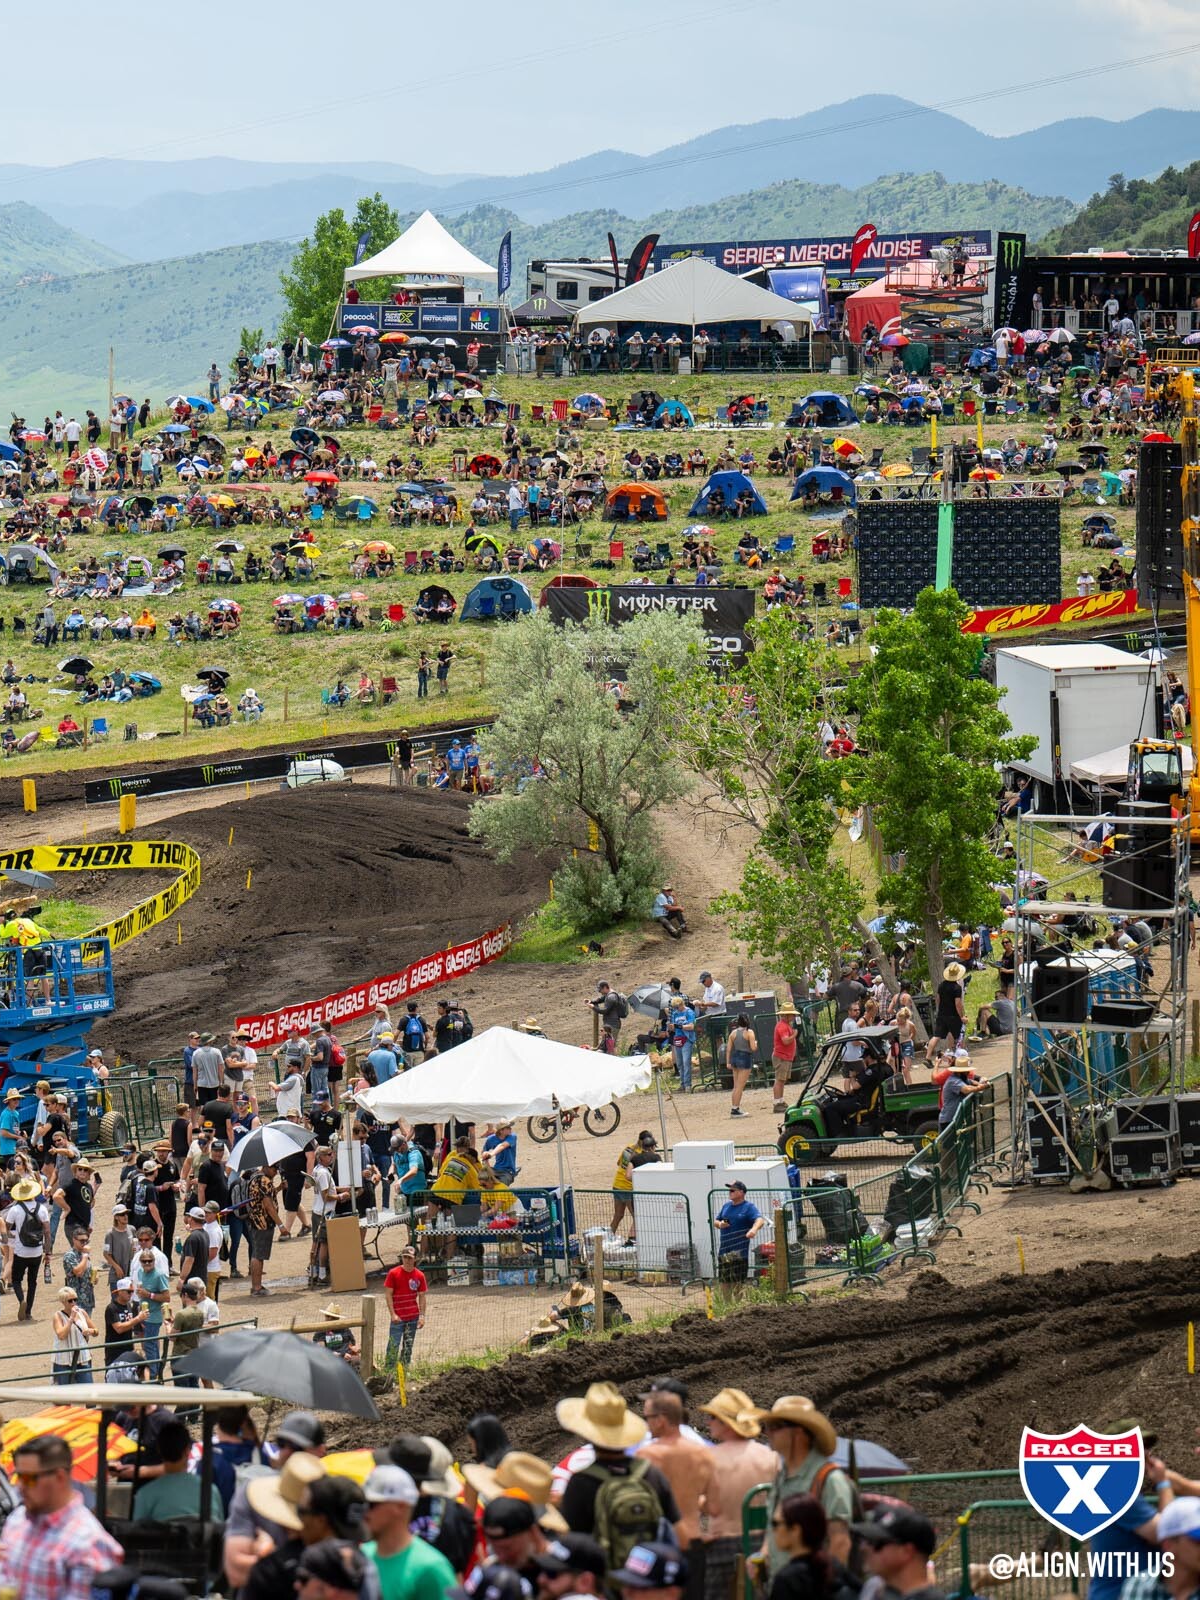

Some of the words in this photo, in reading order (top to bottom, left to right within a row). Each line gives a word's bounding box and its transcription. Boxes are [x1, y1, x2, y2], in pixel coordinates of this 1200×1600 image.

[723, 246, 785, 265] SERIES
[789, 239, 922, 262] MERCHNDISE
[343, 313, 376, 323] peacock
[470, 322, 490, 331] NBC
[618, 594, 718, 612] MONSTER
[1060, 590, 1125, 622] FMF
[214, 765, 243, 773] MONSTER
[121, 779, 151, 787] MONSTER
[56, 844, 133, 867] THOR
[148, 843, 187, 867] THOR
[325, 990, 365, 1021] GASGAS
[368, 974, 408, 1006] GASGAS
[410, 957, 443, 989] GASGAS
[445, 943, 481, 974] GASGAS
